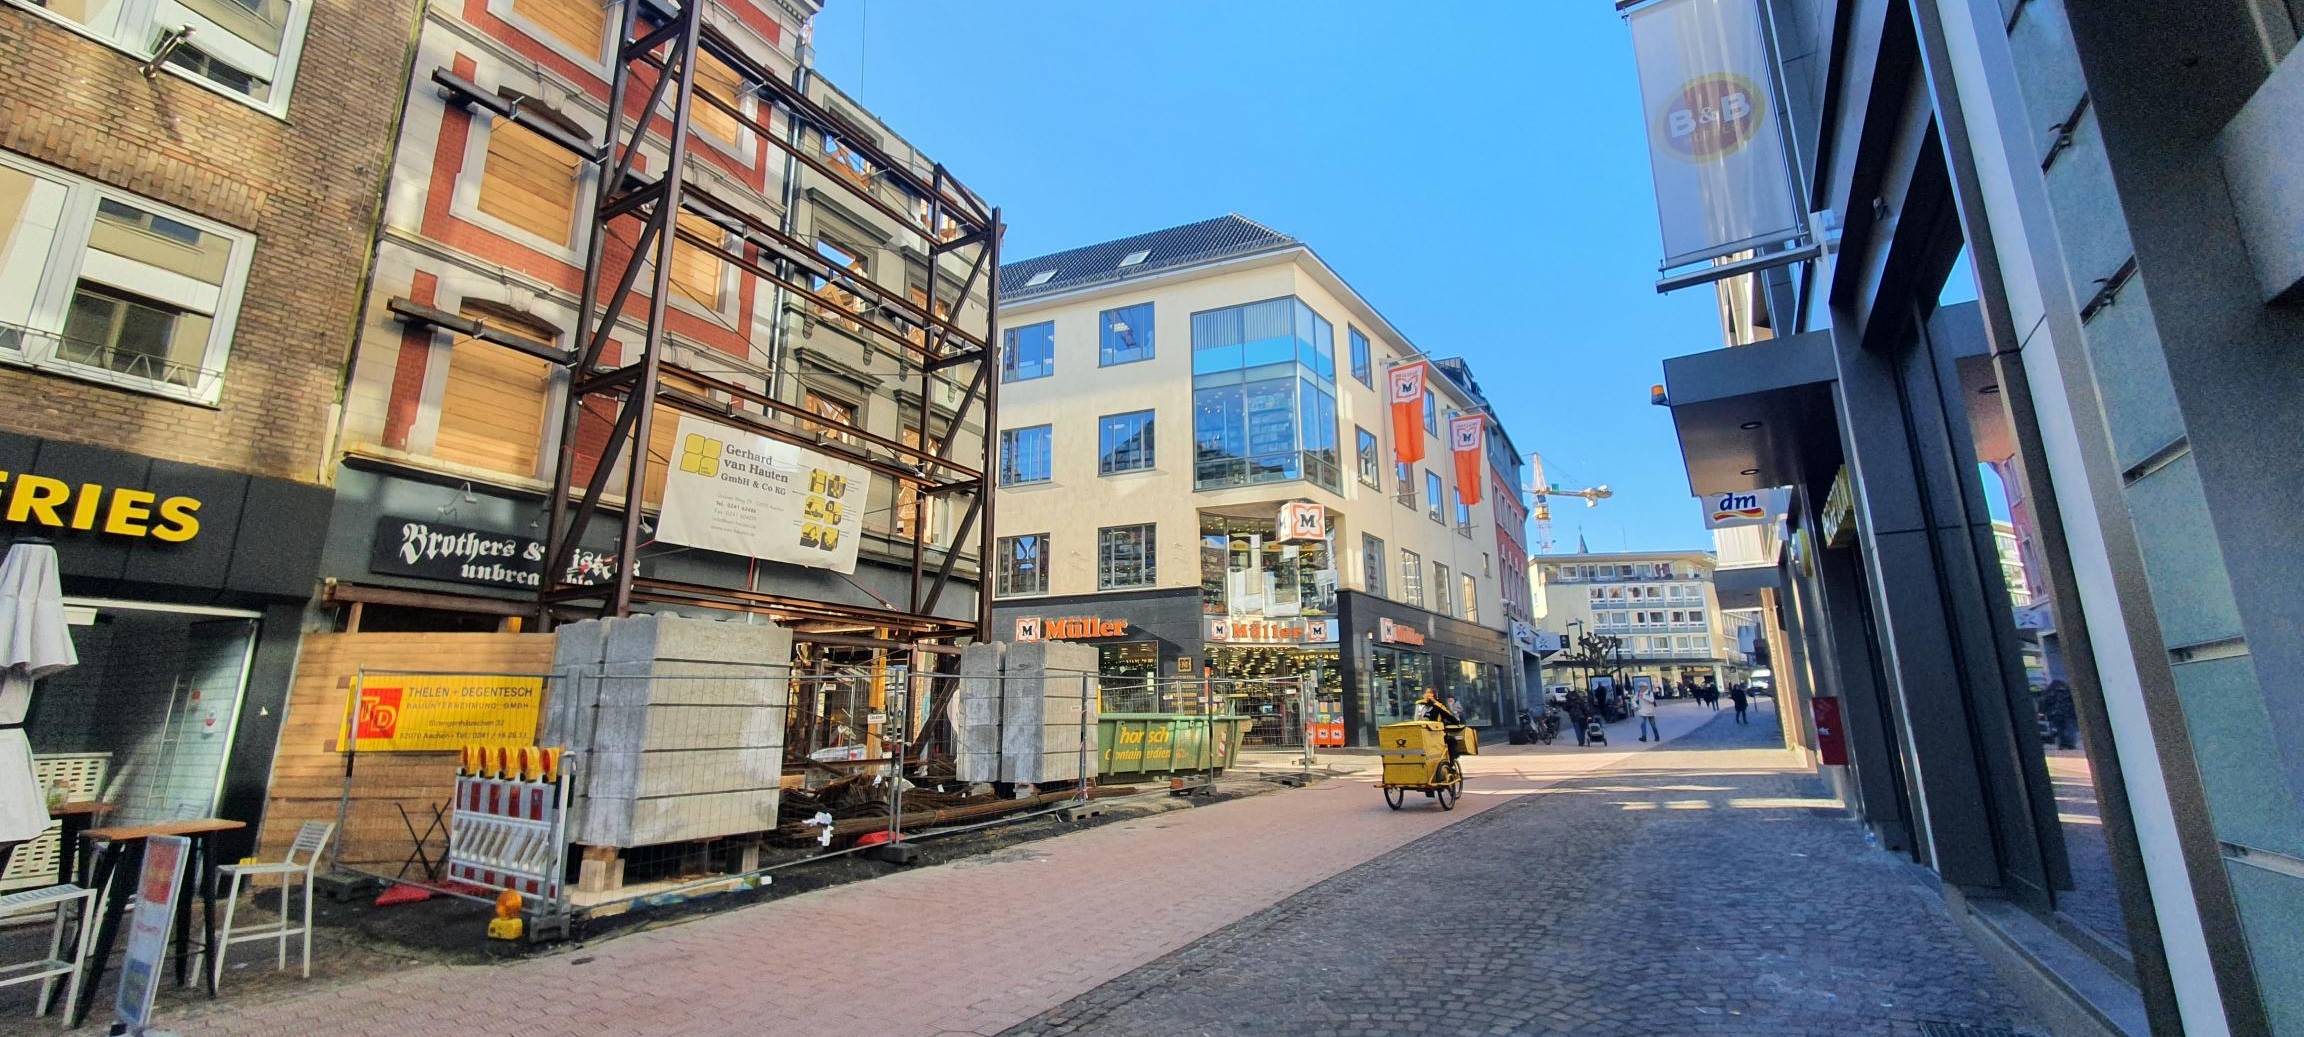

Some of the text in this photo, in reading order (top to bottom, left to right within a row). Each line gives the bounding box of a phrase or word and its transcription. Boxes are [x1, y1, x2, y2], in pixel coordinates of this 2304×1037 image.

[726, 444, 773, 466] Gerhard
[724, 459, 746, 471] van
[750, 464, 789, 483] Hauten
[721, 472, 750, 486] GmbH
[752, 480, 759, 489] &
[761, 482, 773, 492] Co
[775, 486, 786, 496] KG
[1720, 492, 1756, 511] dm
[1300, 514, 1316, 528] M
[399, 522, 516, 565] Brothers
[523, 541, 546, 562] &
[1022, 616, 1129, 640] M Müller
[1232, 621, 1304, 640] Müller
[1313, 627, 1322, 635] M
[409, 687, 450, 698] THELEN
[461, 686, 533, 698] DEGENTESCH
